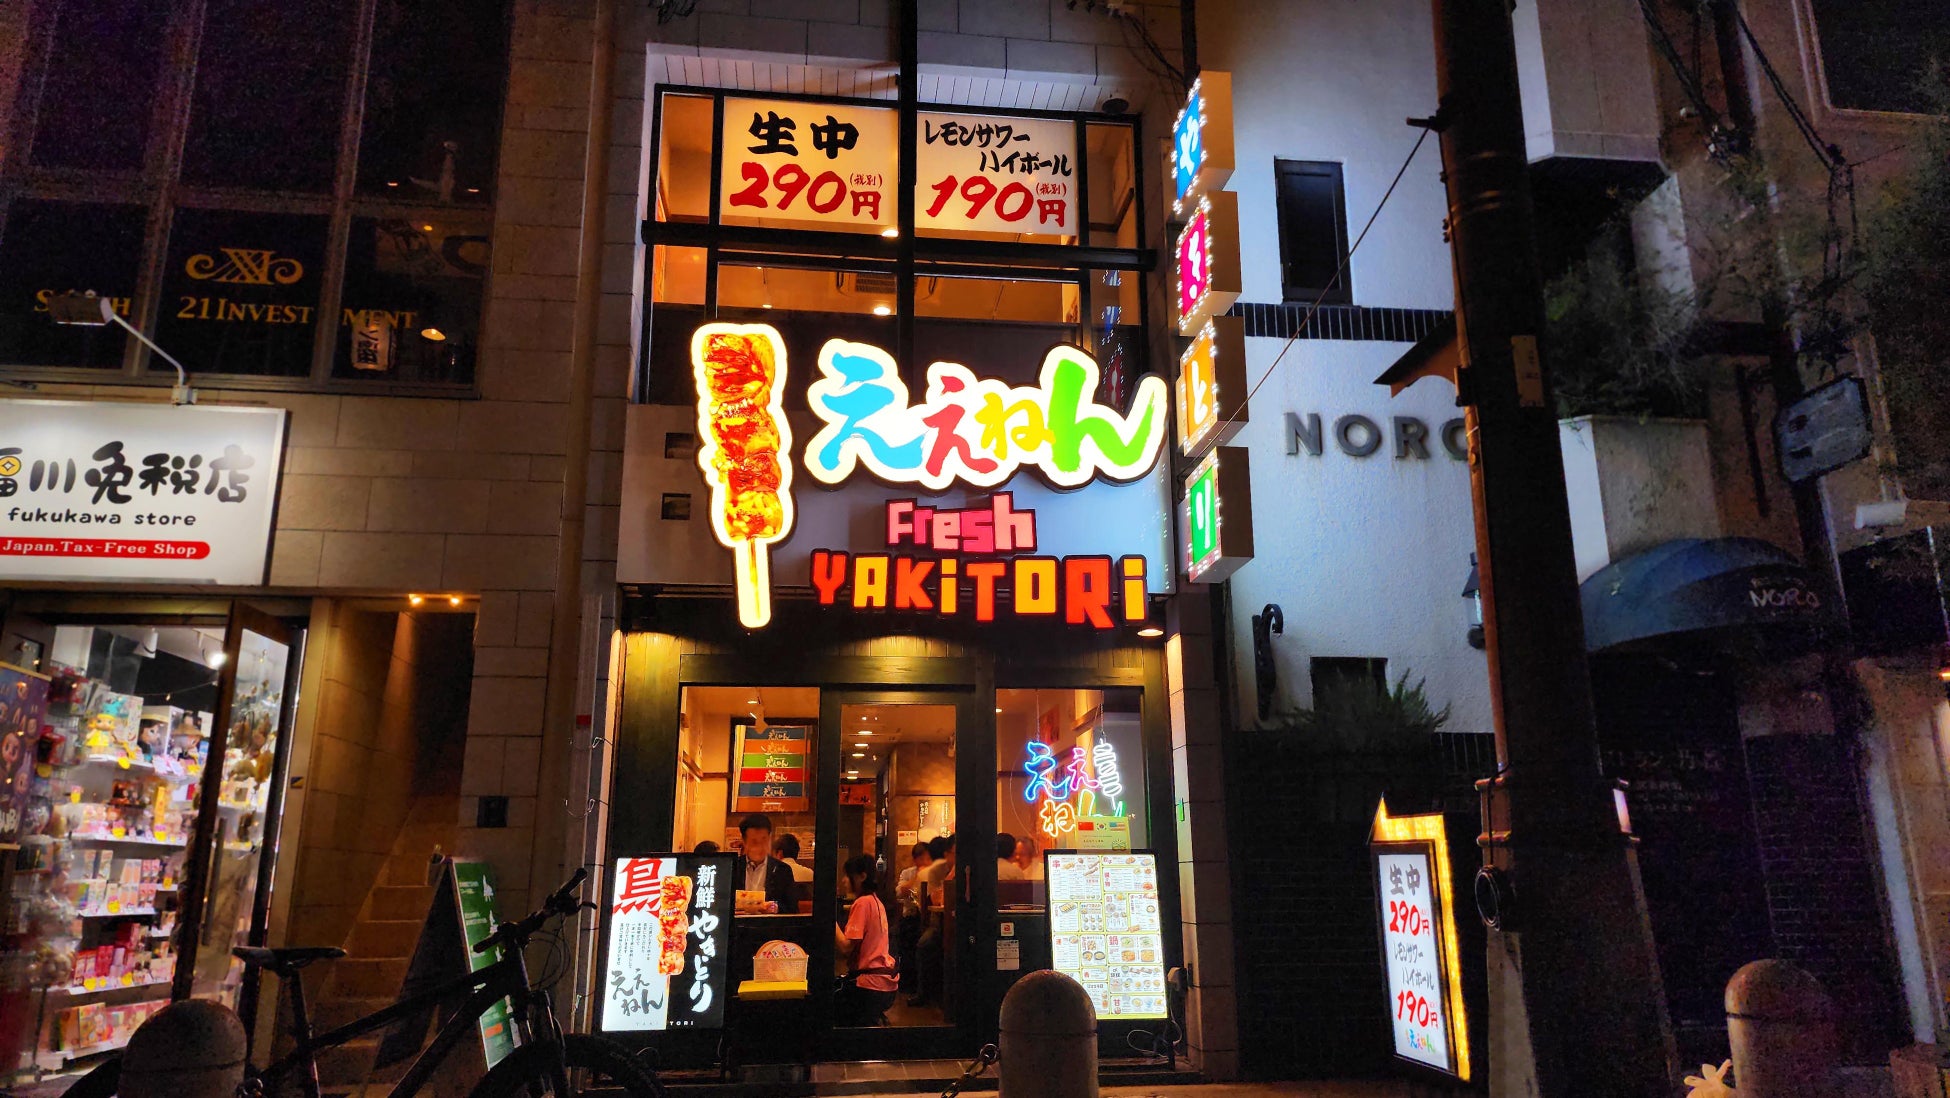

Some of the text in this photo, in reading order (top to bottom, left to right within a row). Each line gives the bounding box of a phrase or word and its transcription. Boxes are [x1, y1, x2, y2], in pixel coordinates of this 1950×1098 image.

[747, 111, 860, 159] 生中
[923, 119, 1031, 152] レモンサワー
[978, 151, 1072, 177] ハイボール
[729, 162, 881, 220] 290円
[925, 175, 1067, 228] 190円
[820, 351, 1155, 478] ええねん
[8, 507, 196, 526] fukukawa store
[888, 492, 1035, 551] Fresh
[153, 542, 197, 558] Shop
[695, 864, 717, 909] 新鮮
[1389, 863, 1421, 897] 生中
[1389, 900, 1430, 937] 290円
[689, 910, 719, 1013] やきとり
[1402, 967, 1435, 992] ハイボール
[1397, 990, 1439, 1030] 190円
